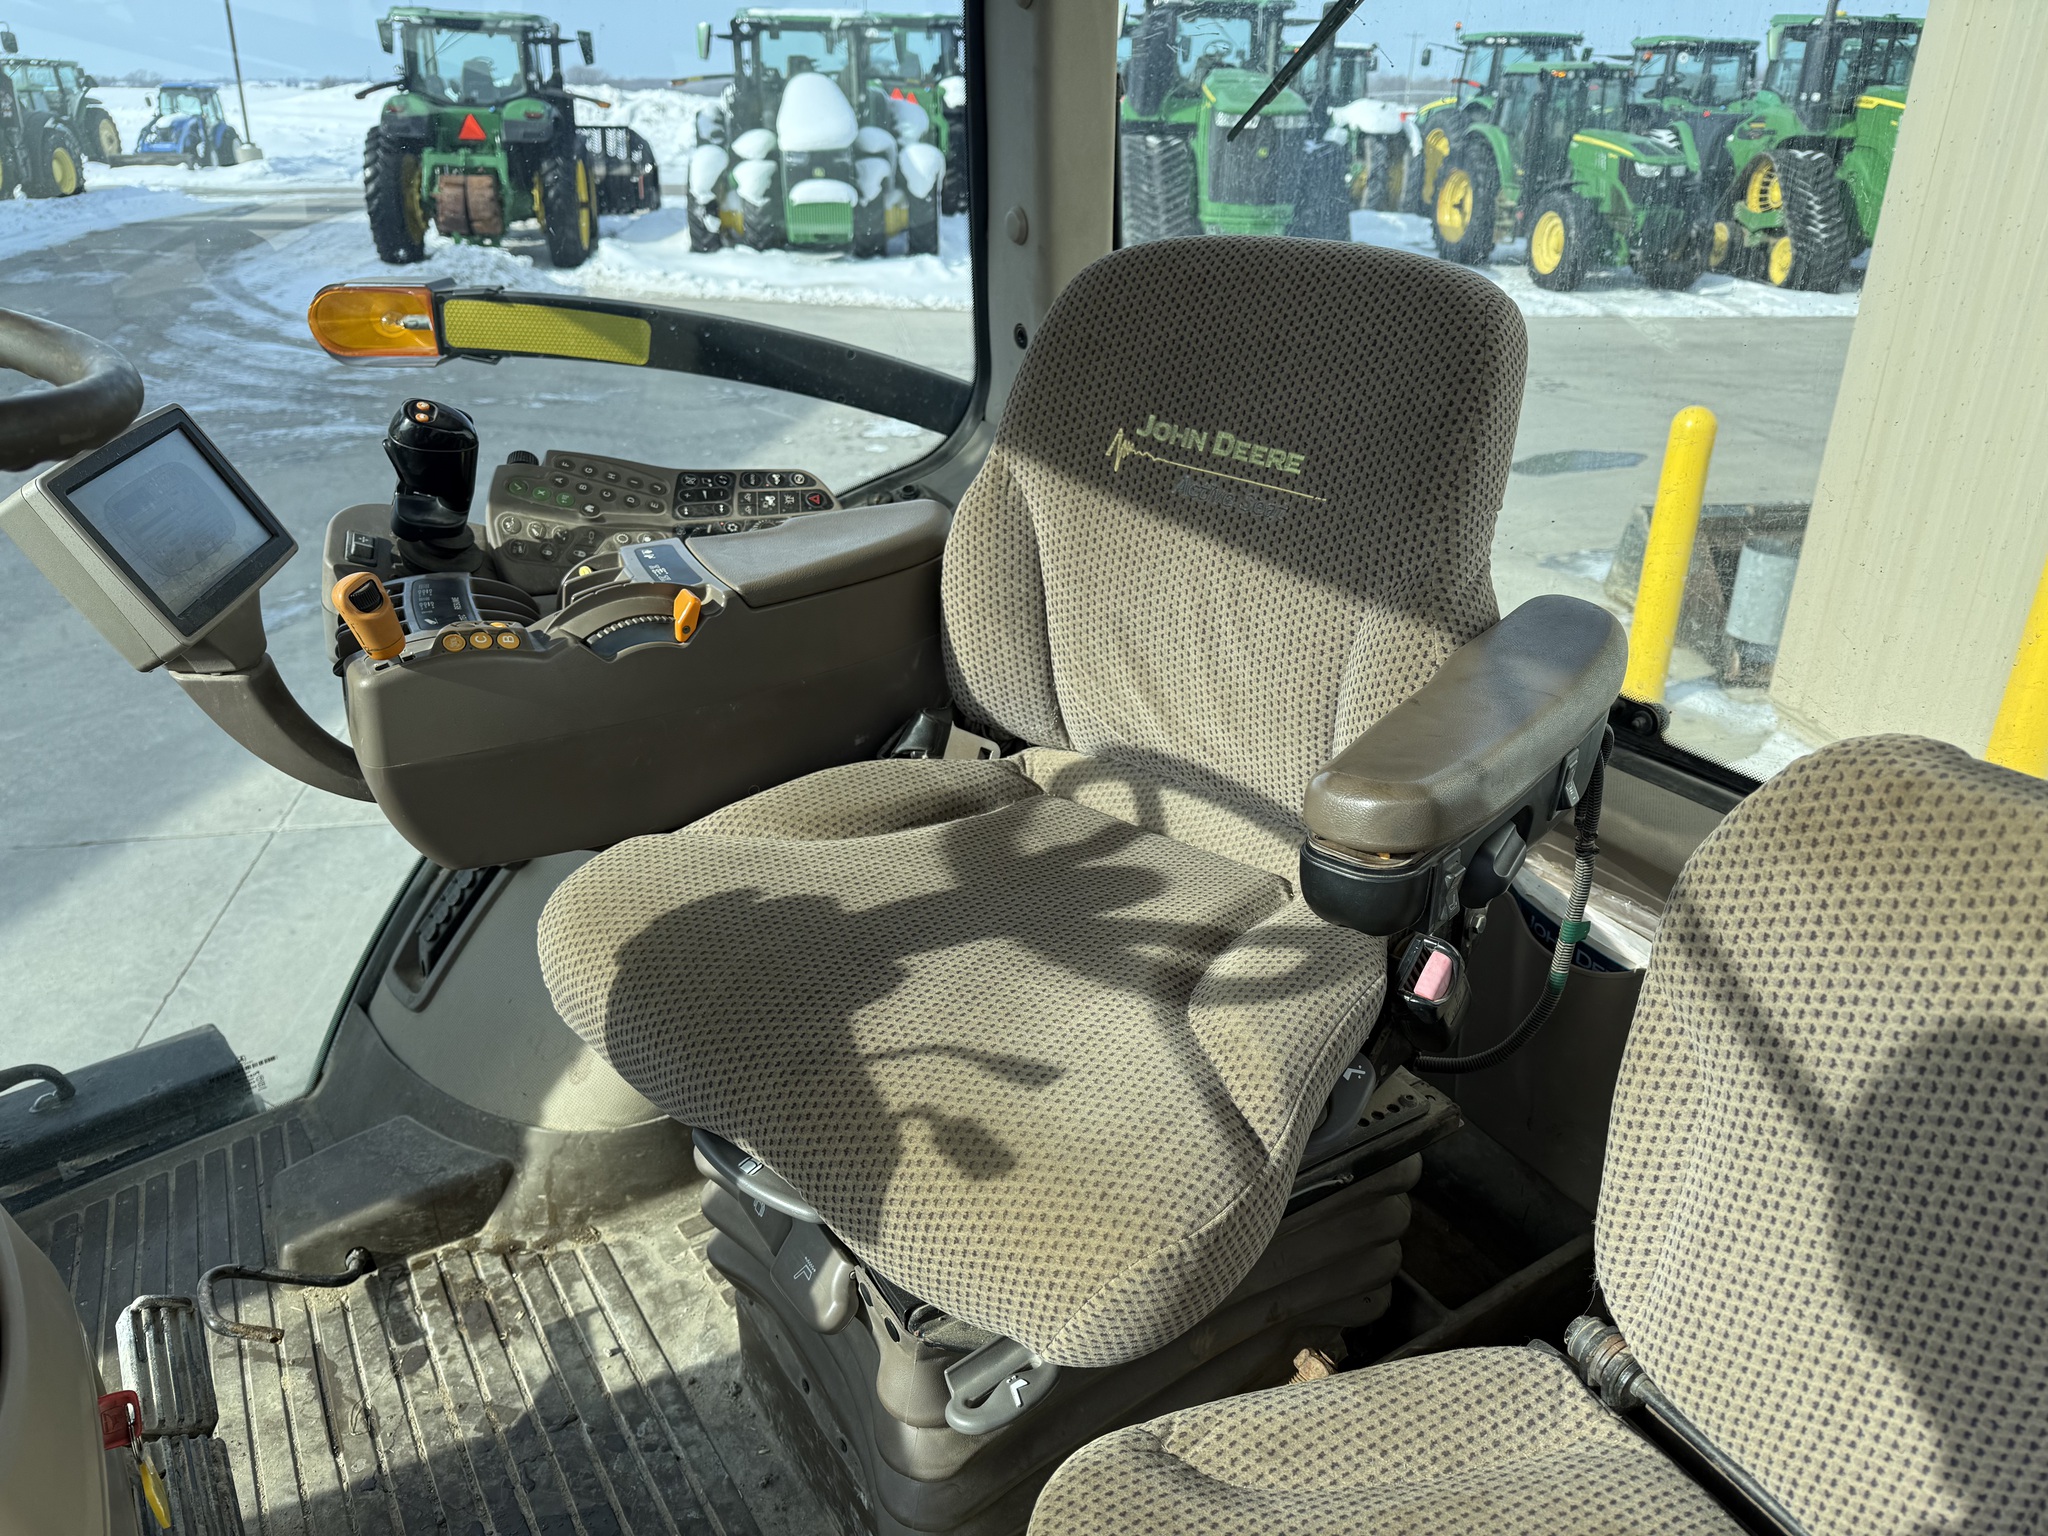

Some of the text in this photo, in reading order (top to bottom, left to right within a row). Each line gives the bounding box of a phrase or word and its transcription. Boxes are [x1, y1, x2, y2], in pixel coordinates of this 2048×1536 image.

[1136, 414, 1305, 475] JOHN DEERE
[1172, 475, 1235, 508] Active
[475, 636, 487, 644] C
